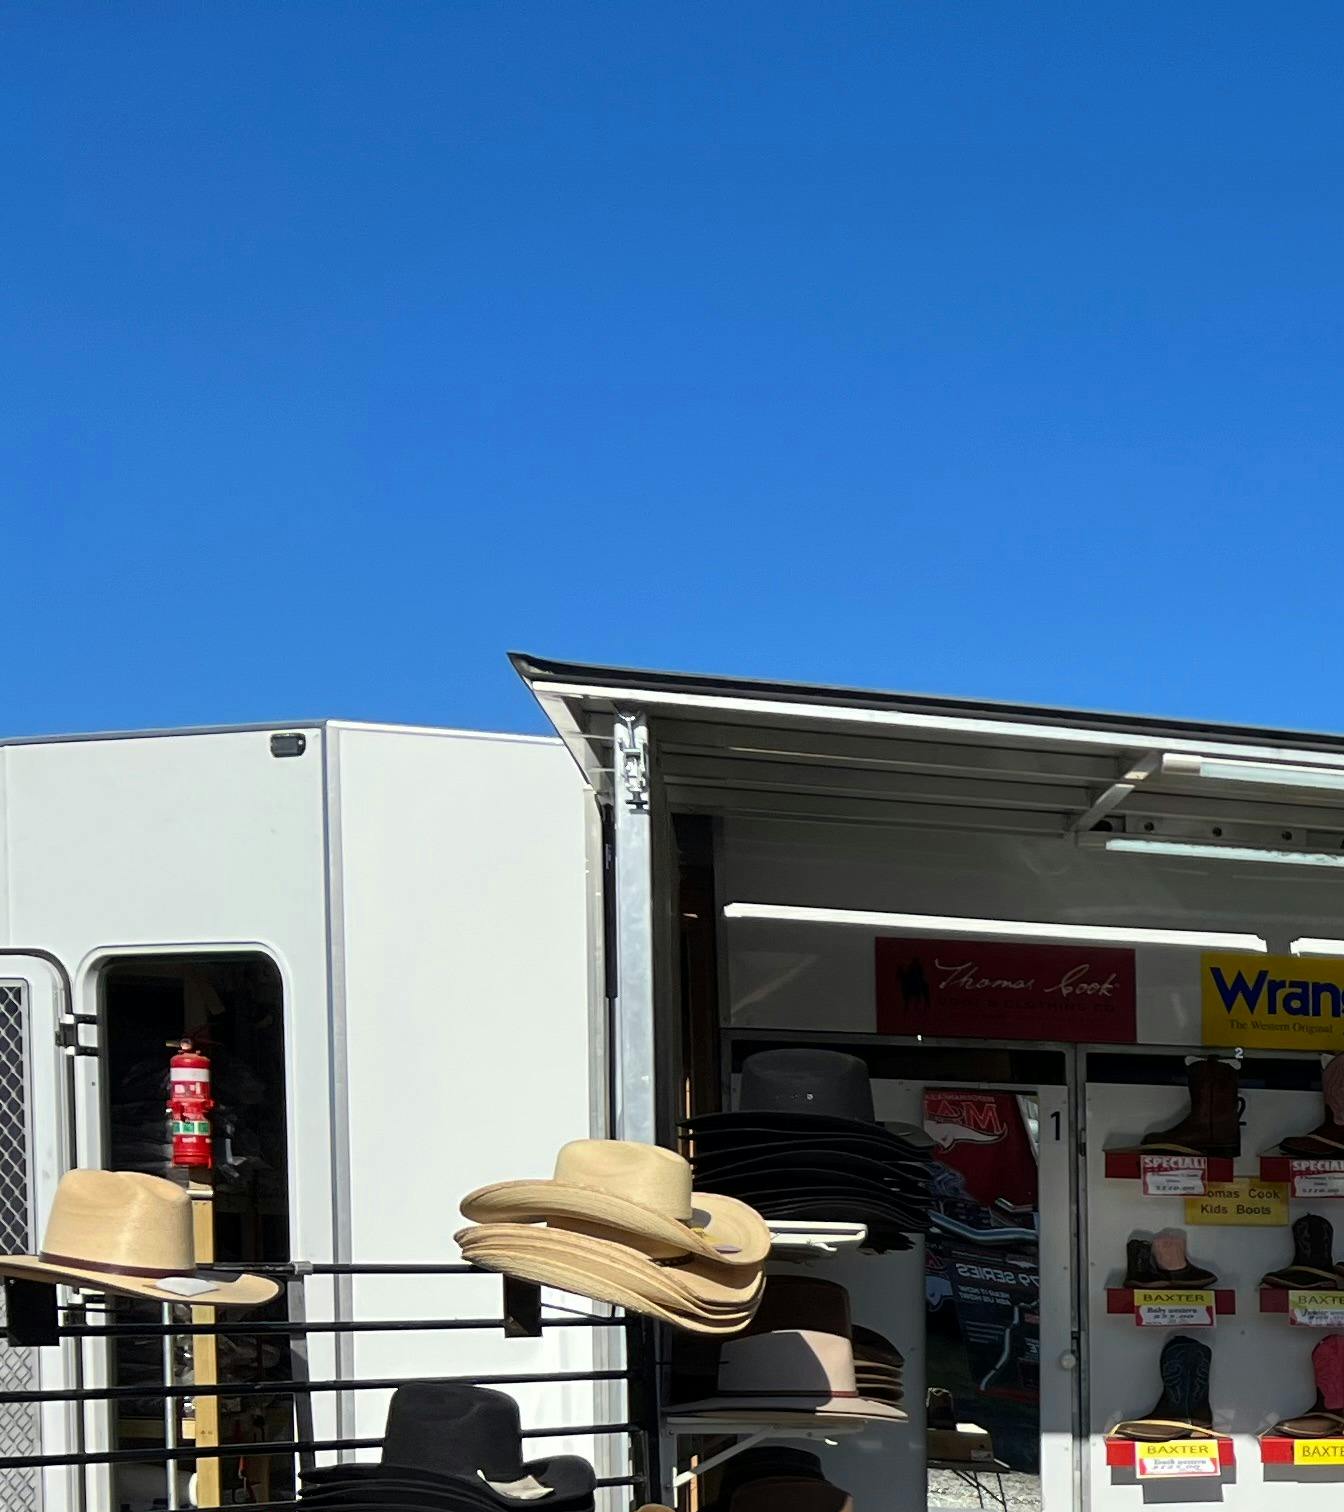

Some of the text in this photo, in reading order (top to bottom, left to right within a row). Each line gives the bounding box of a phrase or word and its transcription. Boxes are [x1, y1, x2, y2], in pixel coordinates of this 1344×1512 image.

[935, 958, 1036, 990] Thomas
[1230, 1018, 1333, 1036] The Western Original
[1050, 1111, 1060, 1141] 1
[1207, 1189, 1281, 1200] omas Cook
[1200, 1204, 1272, 1215] Kids Boots
[1143, 1293, 1205, 1303] BAXTER
[1147, 1445, 1209, 1455] BAXTER
